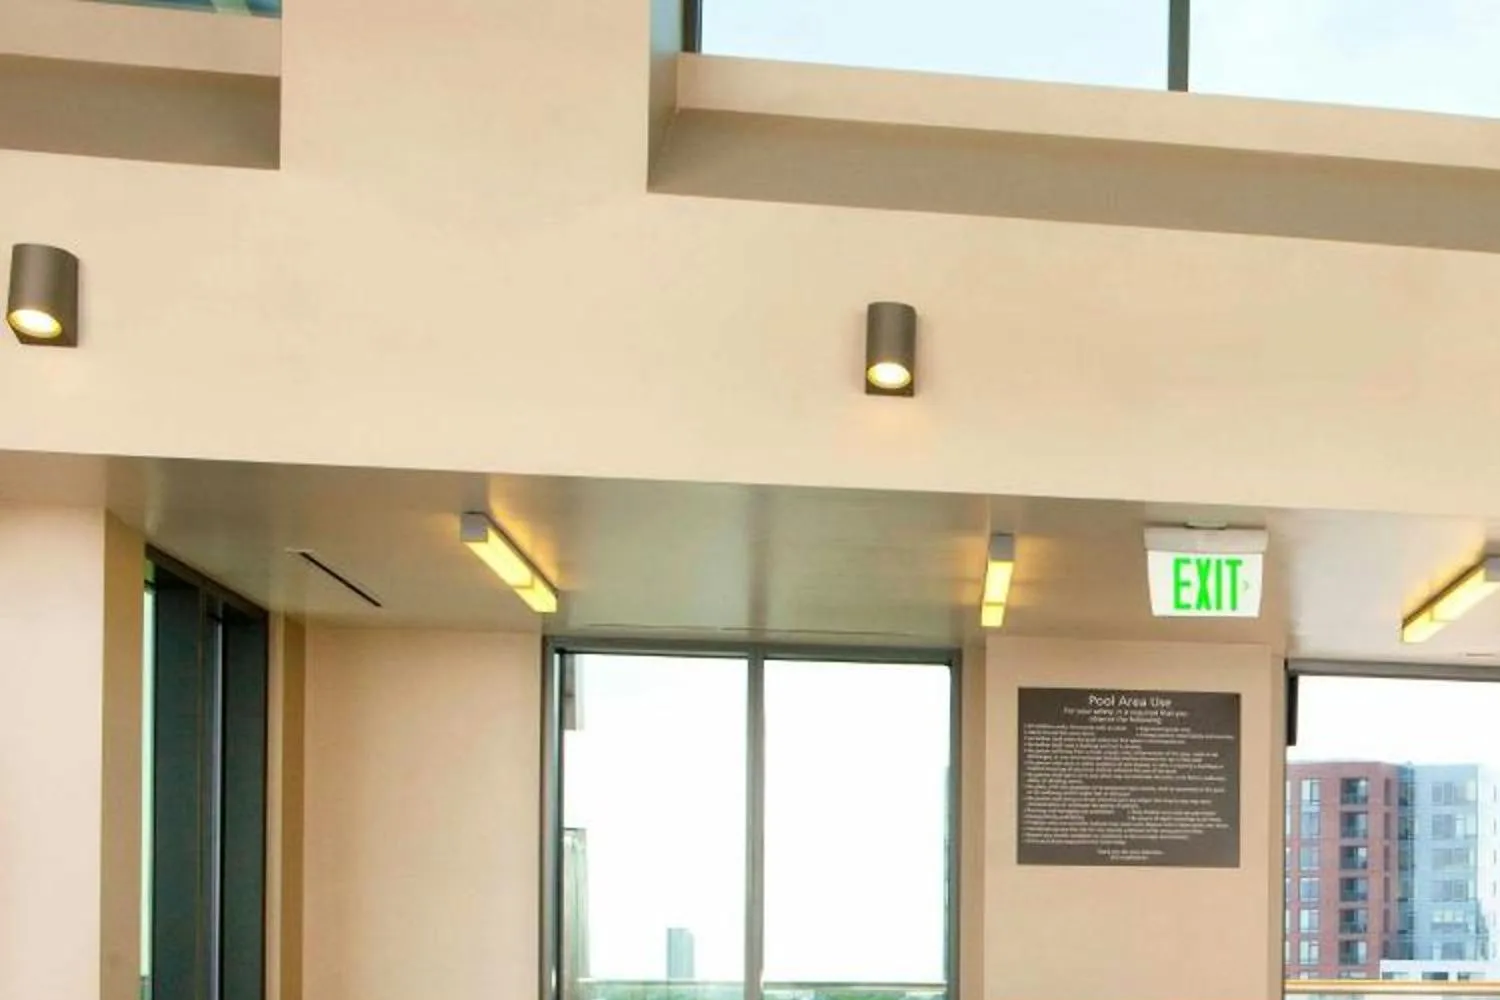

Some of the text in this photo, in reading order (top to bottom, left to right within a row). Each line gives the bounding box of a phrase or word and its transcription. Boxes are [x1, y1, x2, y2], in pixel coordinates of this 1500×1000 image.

[1174, 557, 1243, 611] EXIT
[1088, 695, 1172, 708] Pool Area Use
